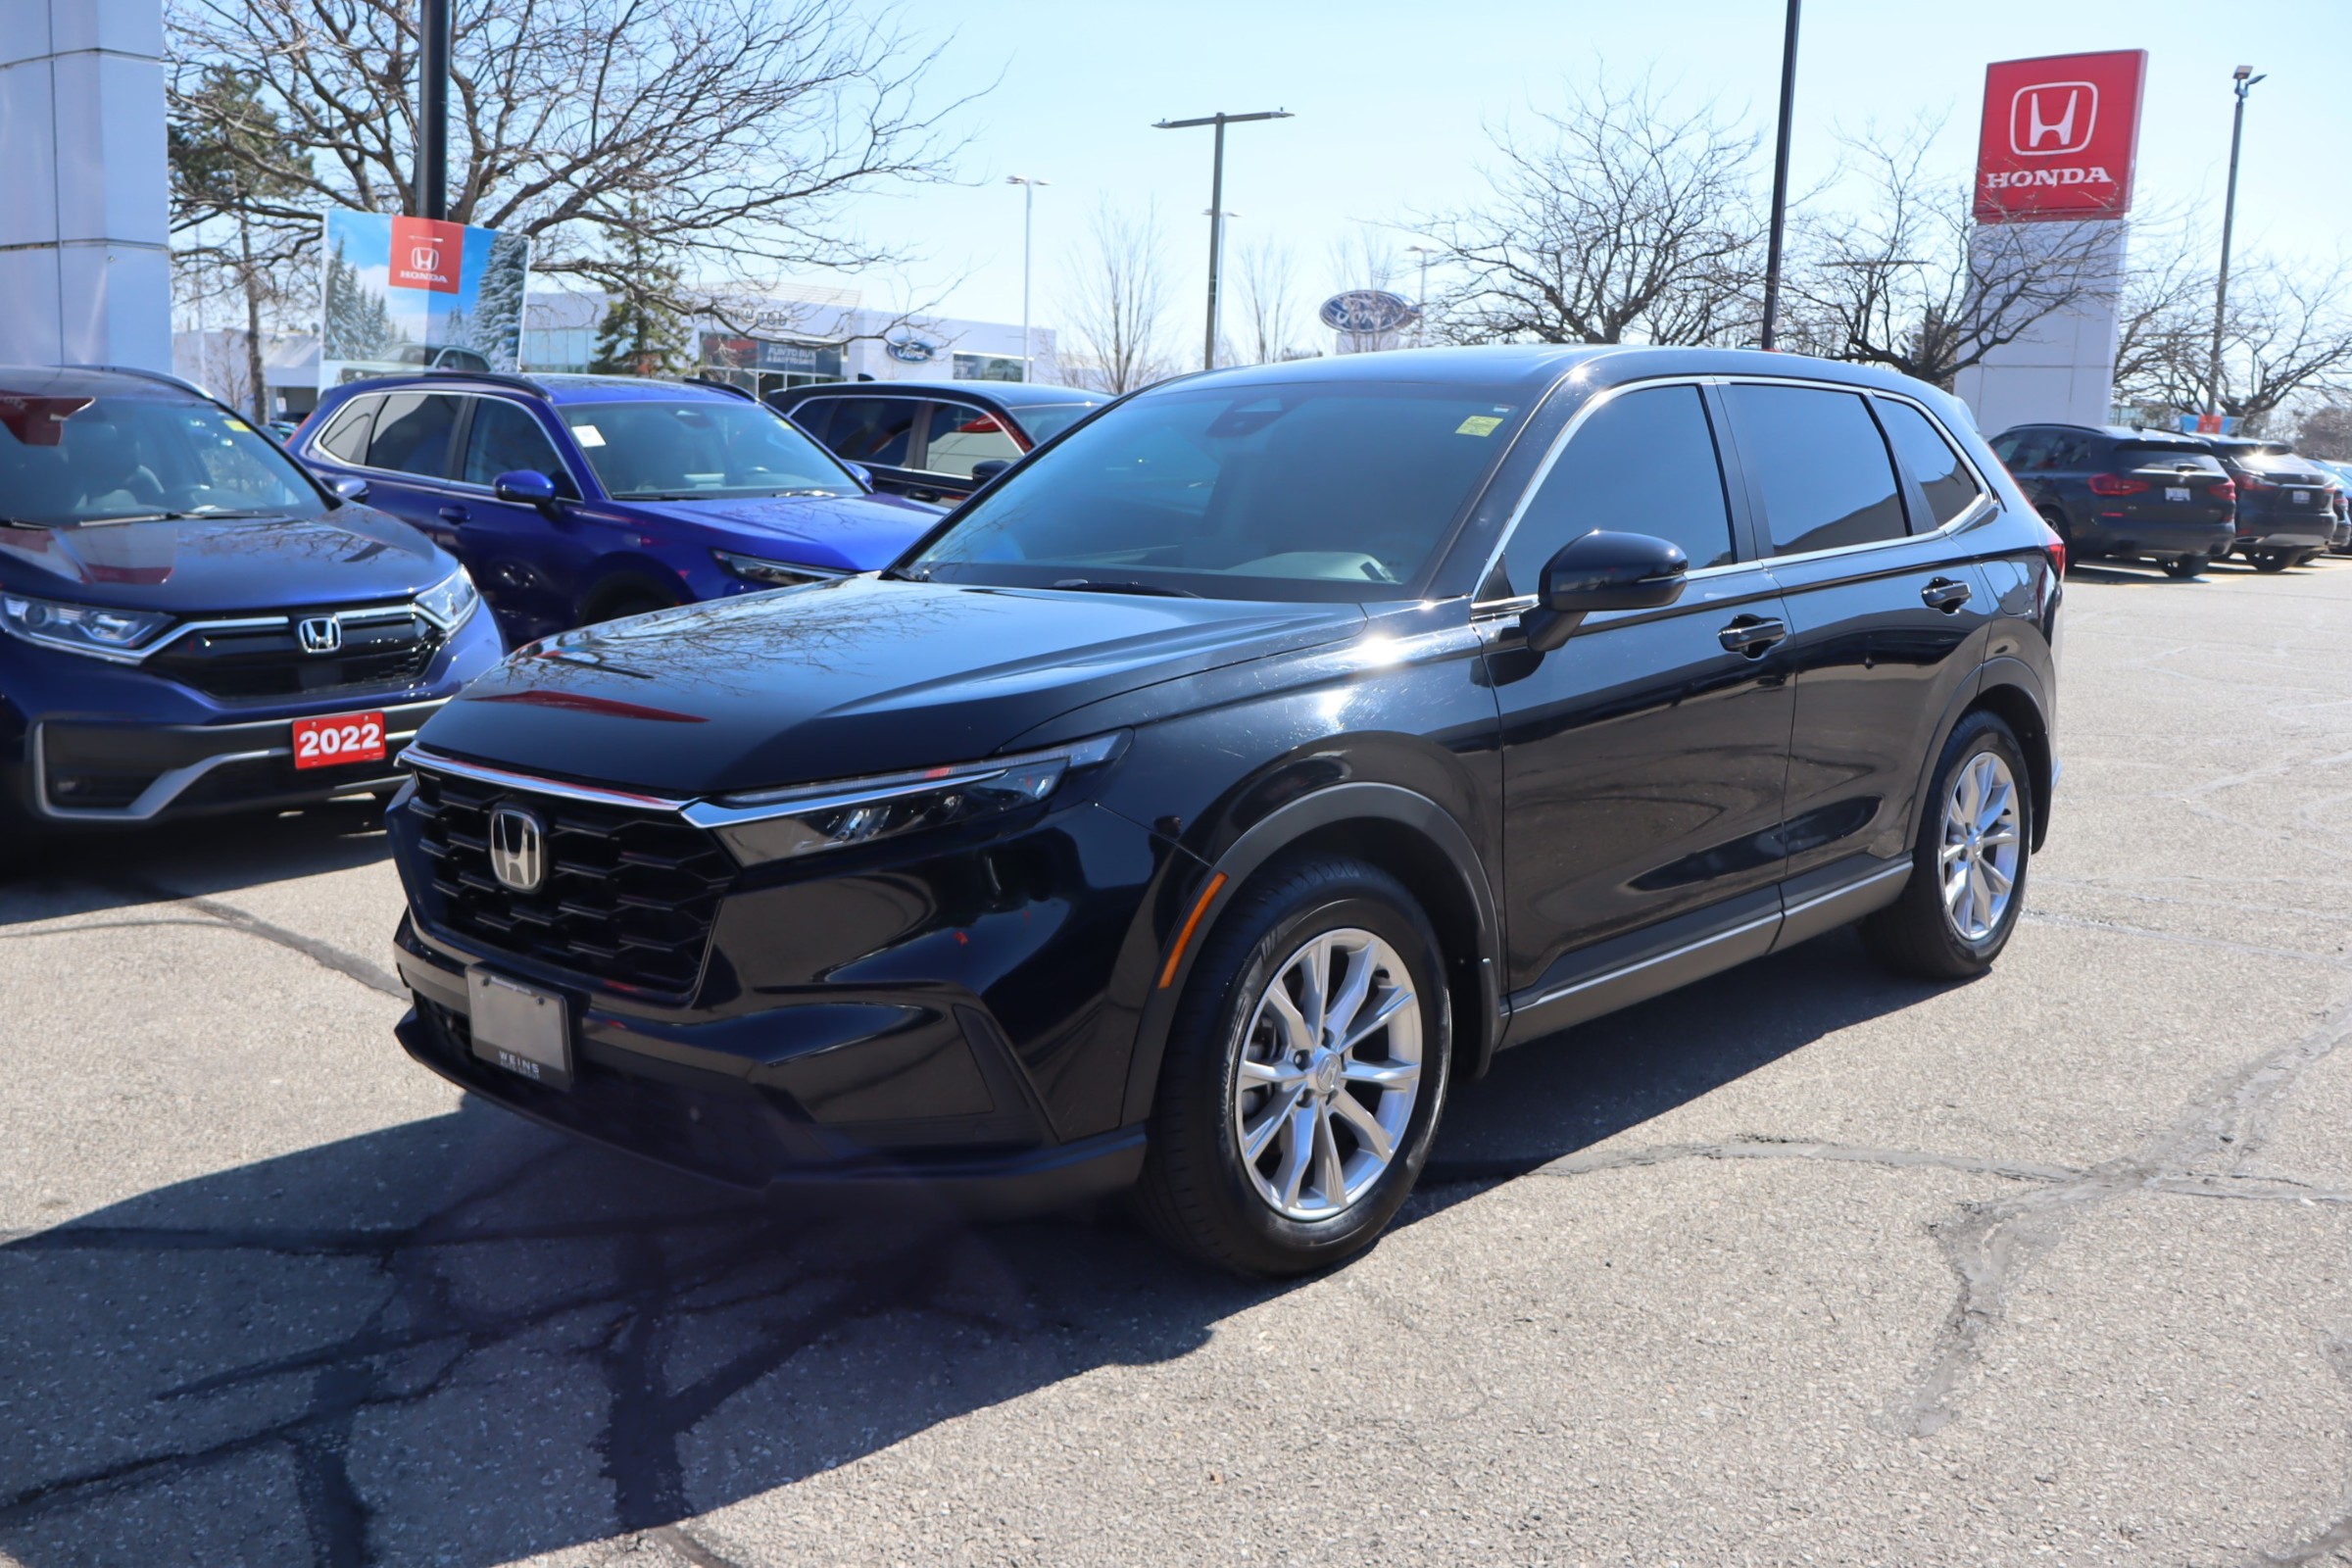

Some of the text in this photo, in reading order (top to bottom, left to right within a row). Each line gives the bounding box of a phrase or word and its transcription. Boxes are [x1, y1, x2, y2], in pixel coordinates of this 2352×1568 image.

[1984, 167, 2112, 189] HONDA
[399, 270, 449, 284] HONDA
[299, 723, 381, 758] 2022
